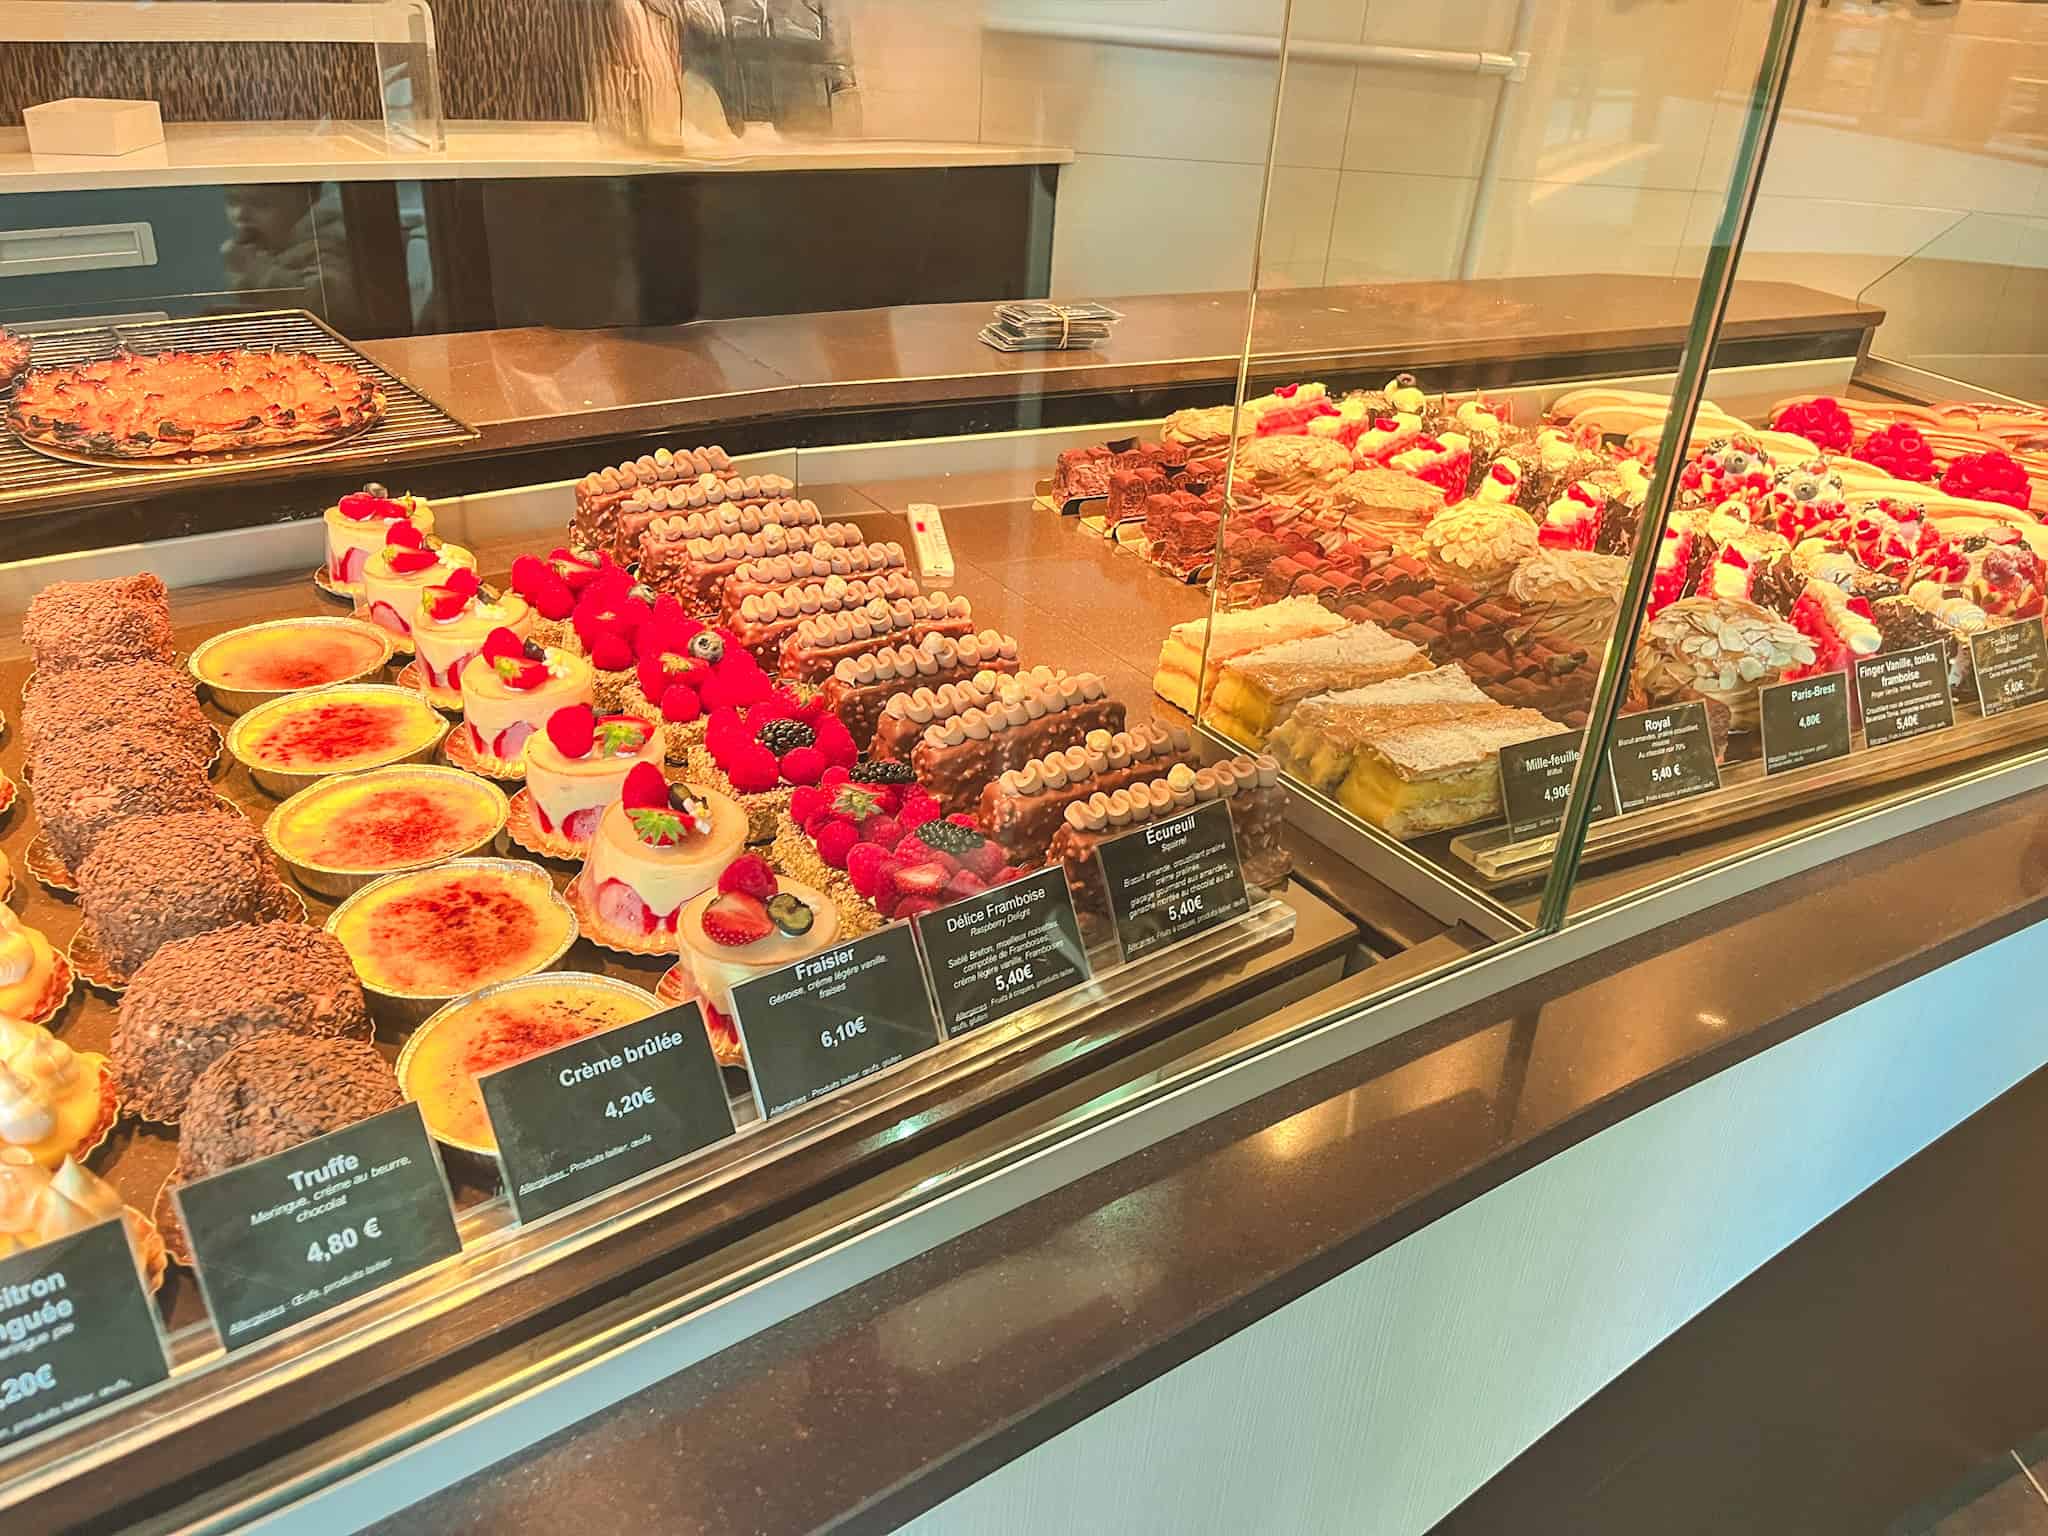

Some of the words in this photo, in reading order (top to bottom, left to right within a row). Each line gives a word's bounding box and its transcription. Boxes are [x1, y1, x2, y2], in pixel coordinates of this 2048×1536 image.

[1859, 664, 1884, 678] Finger
[1885, 656, 1914, 672] Vanille,
[1914, 652, 1938, 665] tonka,
[1881, 670, 1920, 687] framboise
[1791, 683, 1836, 702] Paris-Brest
[1645, 716, 1671, 732] Royal
[1896, 713, 1919, 731] 5,40€
[1651, 765, 1672, 782] 5,40
[1673, 764, 1681, 776] €
[1544, 784, 1572, 801] 4,90€
[1145, 815, 1196, 845] Écureuil
[1155, 878, 1187, 898] gourmand
[1190, 877, 1215, 894] chocolat
[946, 909, 985, 933] Délice
[986, 887, 1046, 919] Framboise
[1168, 895, 1204, 922] 5,40€
[970, 915, 1007, 937] Raspberry
[795, 949, 855, 981] Fraisier
[947, 954, 969, 970] Sablé
[969, 944, 995, 961] Breton,
[807, 977, 833, 992] crème
[834, 966, 860, 982] légère
[818, 982, 847, 999] fraises
[953, 974, 977, 989] crème
[995, 964, 1034, 992] 5,40€
[820, 1016, 867, 1048] 6,10€
[559, 1054, 623, 1087] Crème
[623, 1031, 684, 1063] brûlée
[604, 1086, 656, 1119] 4,20€
[287, 1153, 360, 1192] Truffe
[312, 1177, 353, 1202] crème
[352, 1173, 369, 1186] au
[295, 1194, 348, 1224] chocolat
[306, 1227, 358, 1263] 4,80
[362, 1216, 383, 1239] €
